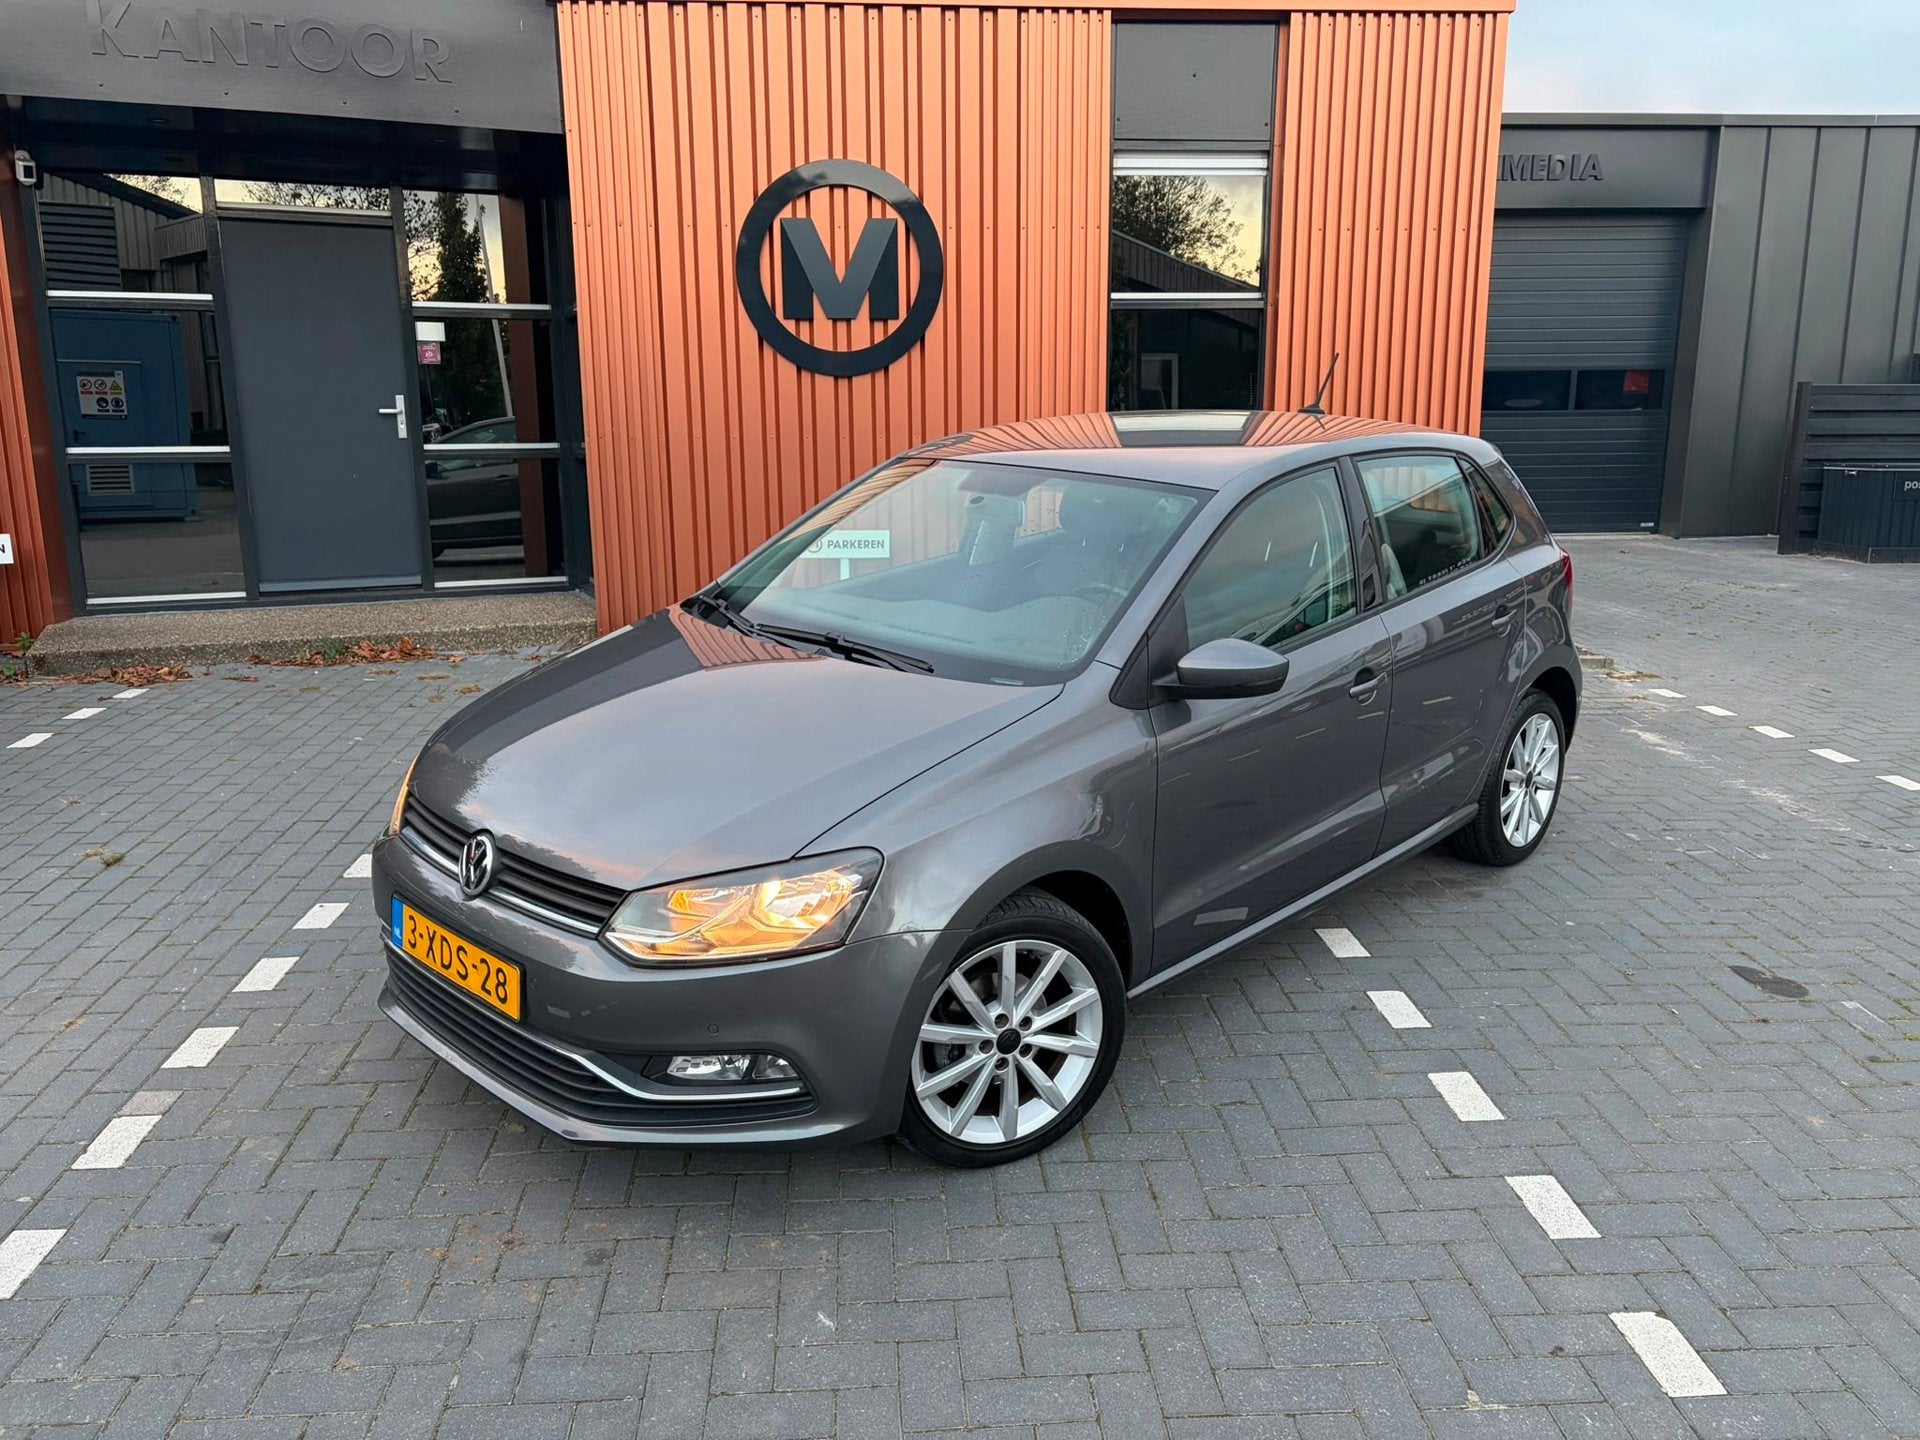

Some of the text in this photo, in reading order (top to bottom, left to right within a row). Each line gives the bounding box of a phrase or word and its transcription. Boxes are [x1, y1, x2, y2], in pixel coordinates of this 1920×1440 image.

[86, 0, 453, 83] KANTOOR
[780, 217, 900, 320] M
[827, 539, 885, 549] PARKEREN
[408, 914, 508, 1005] 3-XDS-28
